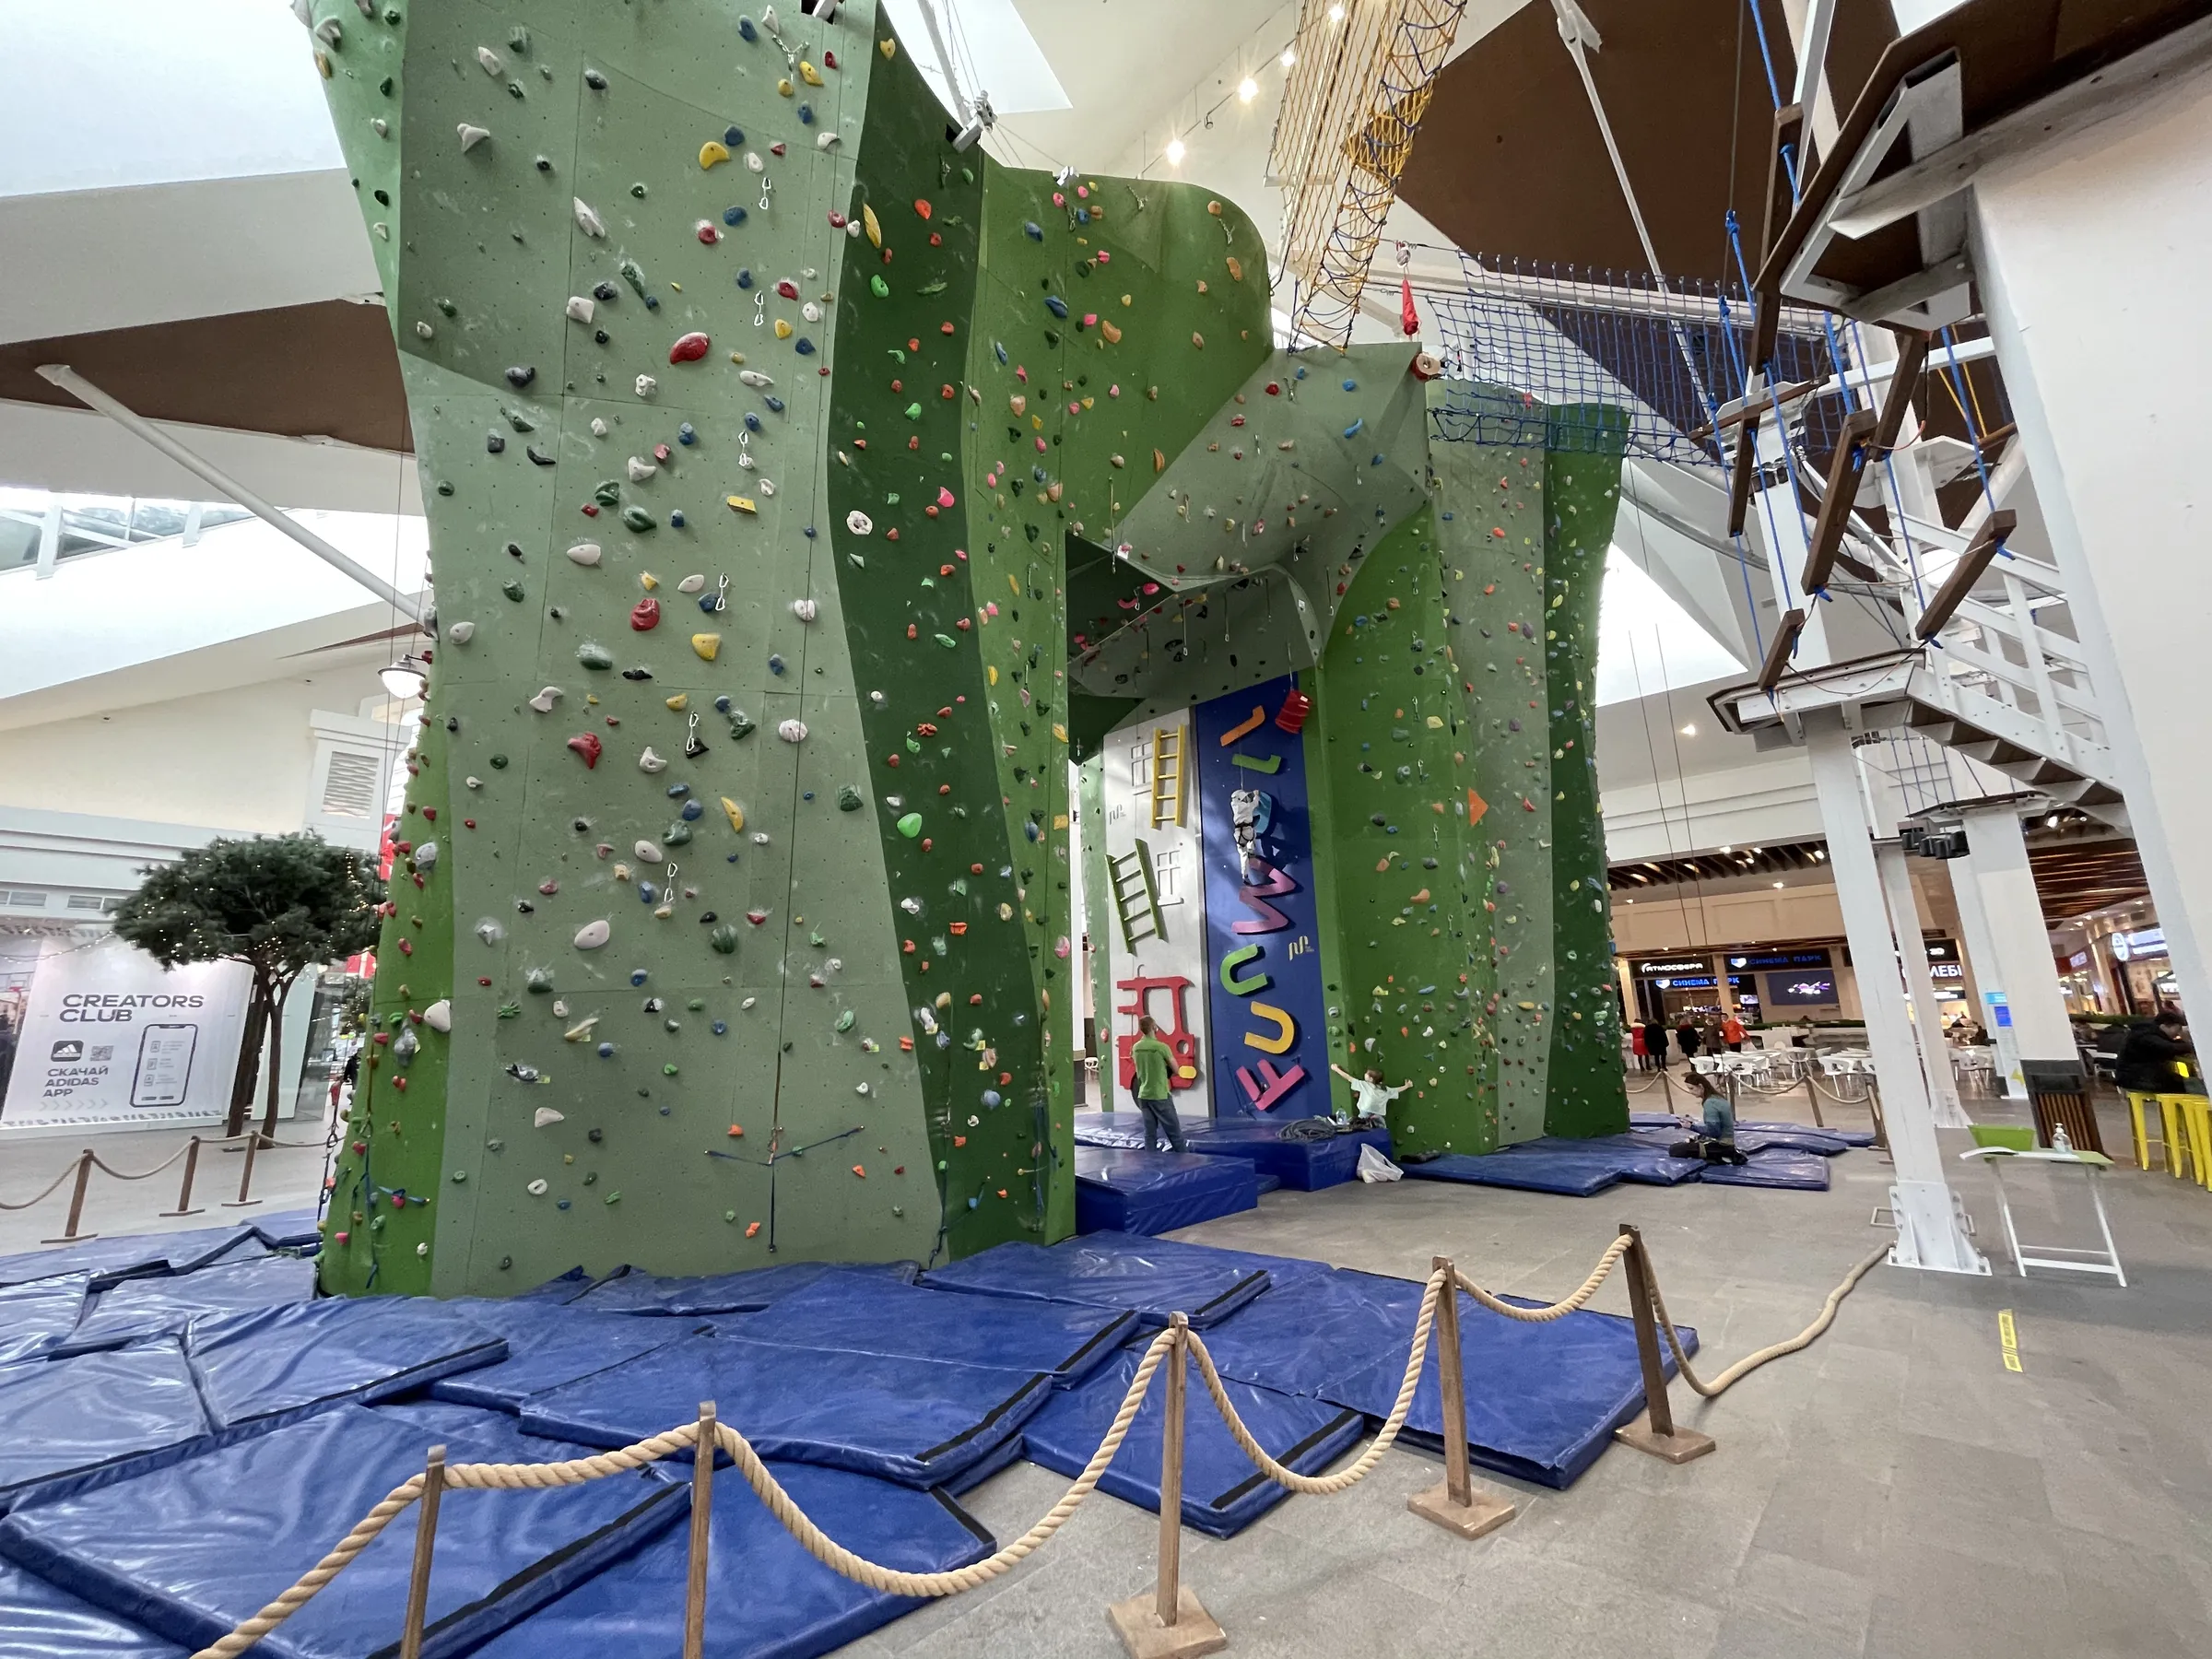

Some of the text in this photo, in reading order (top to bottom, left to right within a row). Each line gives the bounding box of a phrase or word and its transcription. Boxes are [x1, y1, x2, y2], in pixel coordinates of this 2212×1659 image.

[1793, 954, 1822, 962] ПАРК
[1641, 962, 1703, 973] АТМОСФЕРА
[1672, 977, 1739, 987] СИНЕМА ПРК
[63, 994, 205, 1008] CREATORS
[59, 1008, 133, 1022] CLUB
[47, 1065, 109, 1077] СКАЧАЙ
[44, 1077, 100, 1088] ADIDAS
[42, 1088, 74, 1097] APP
